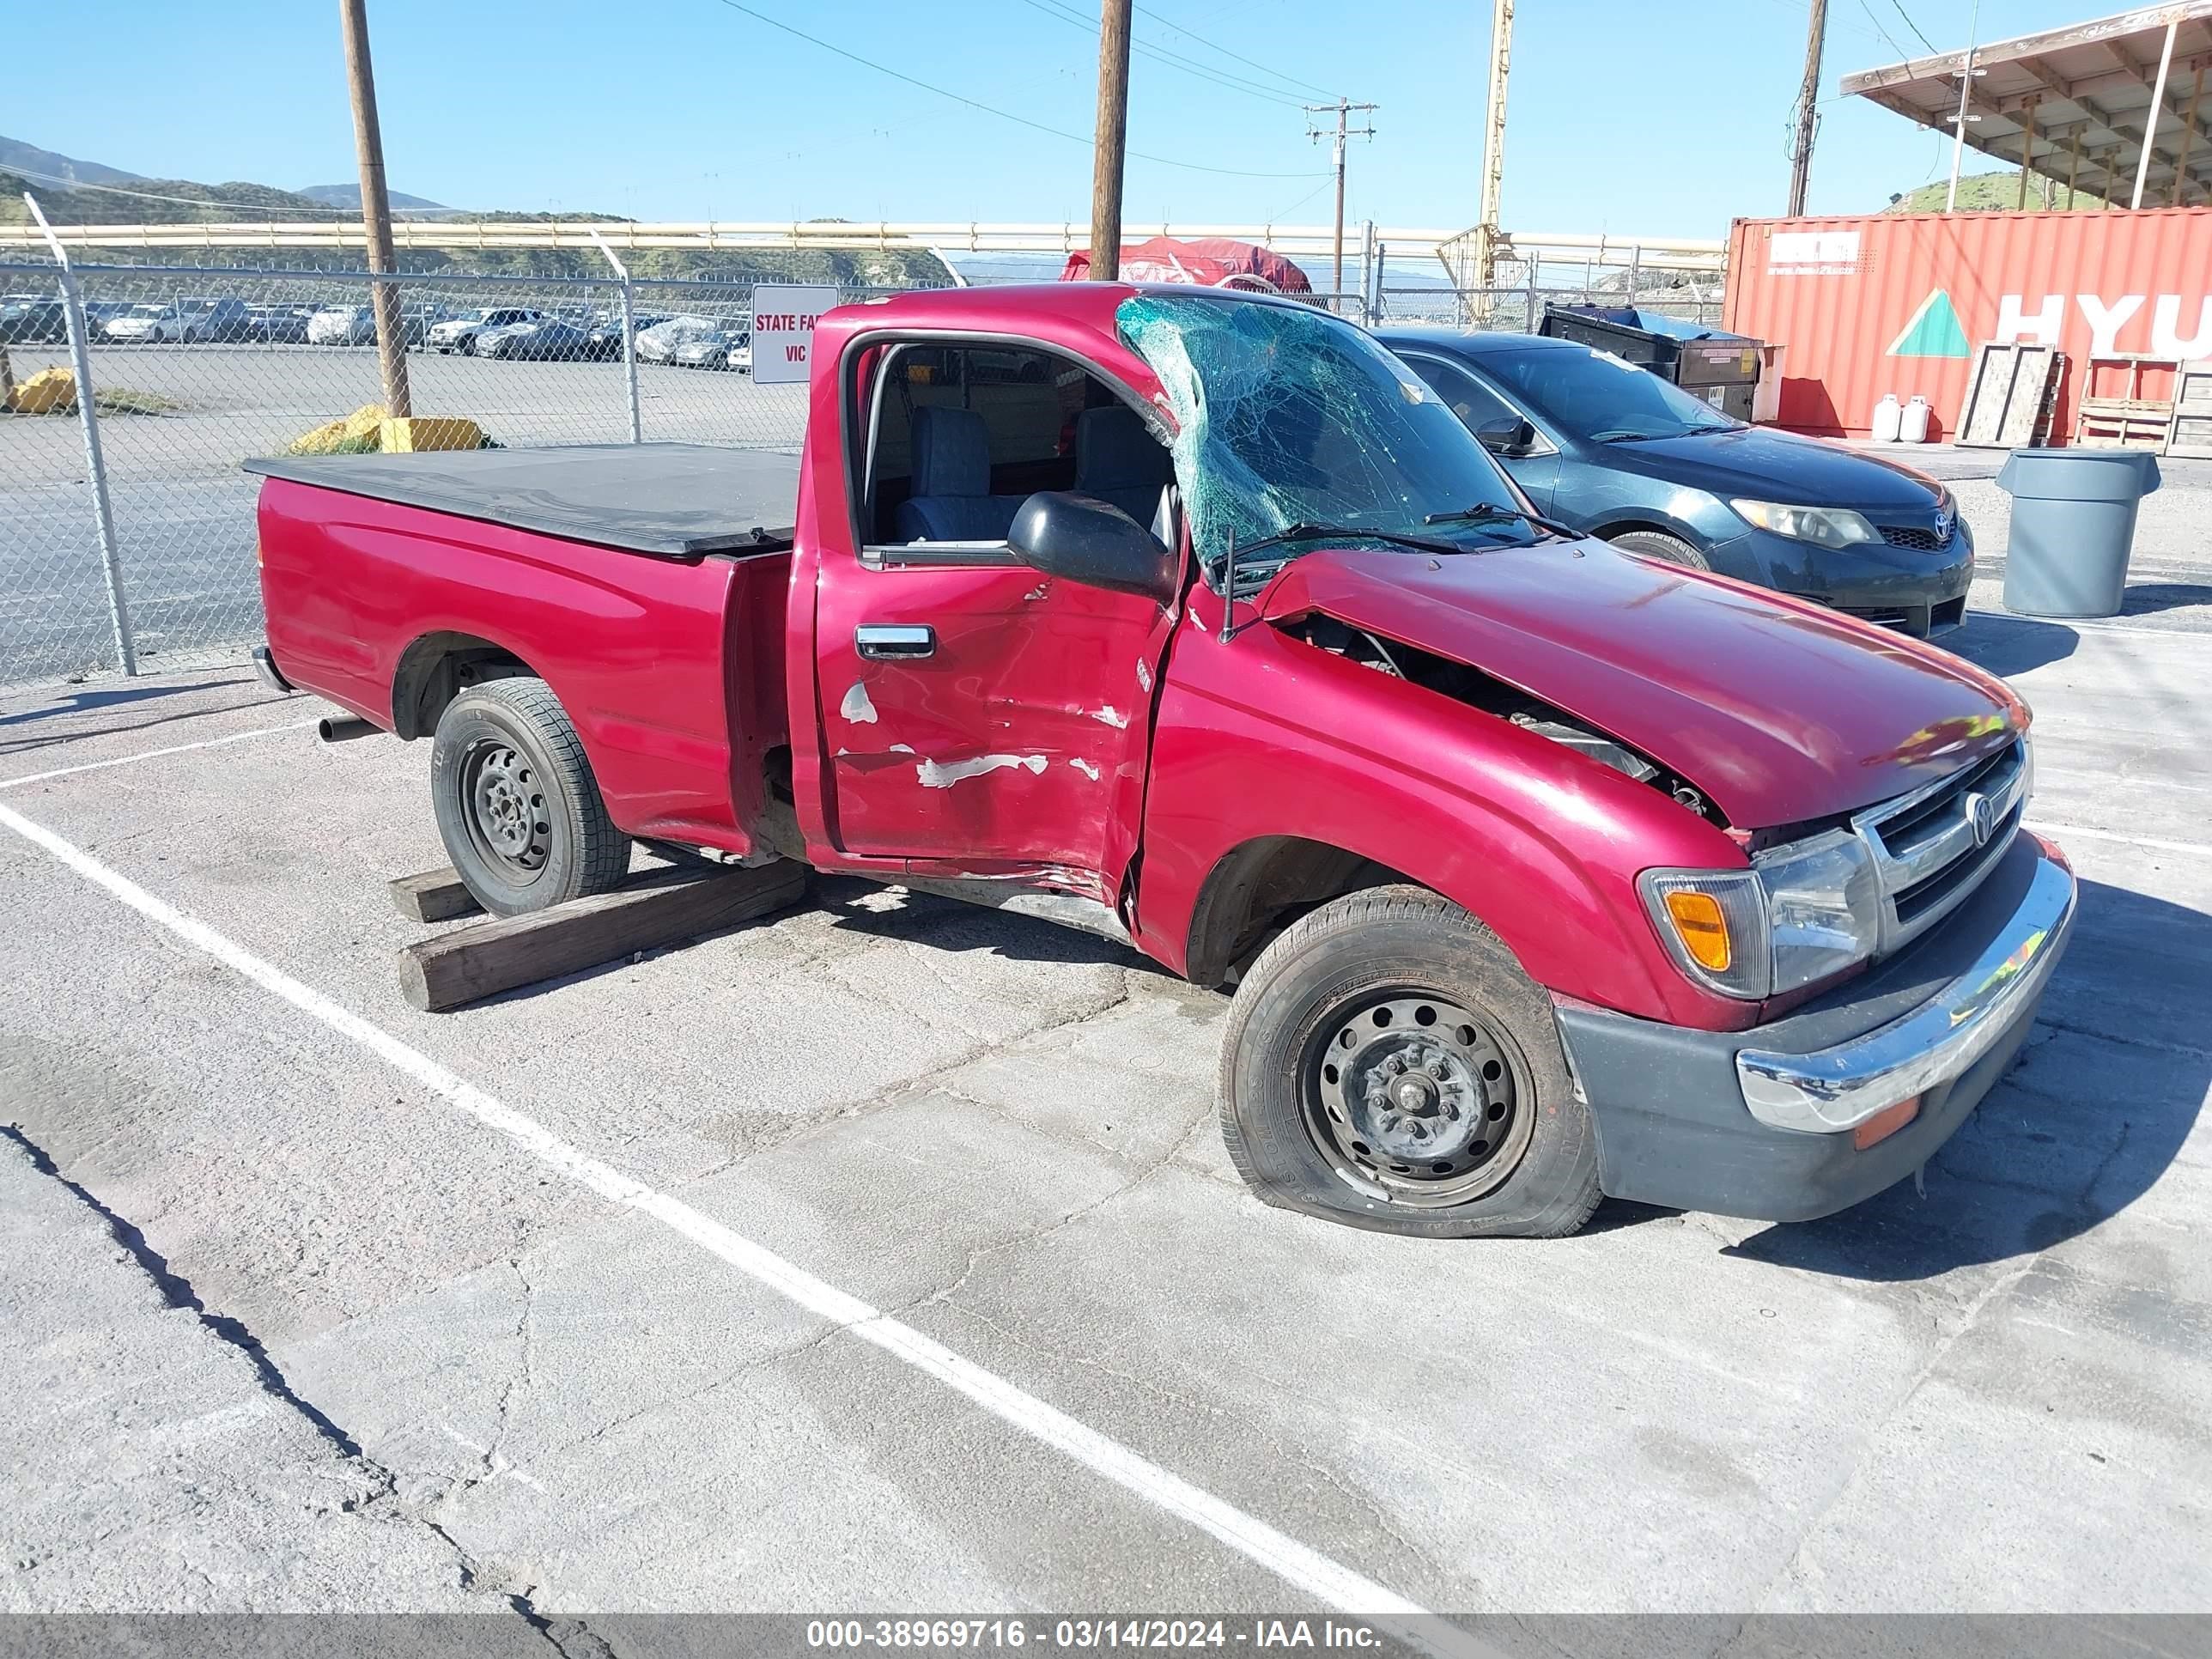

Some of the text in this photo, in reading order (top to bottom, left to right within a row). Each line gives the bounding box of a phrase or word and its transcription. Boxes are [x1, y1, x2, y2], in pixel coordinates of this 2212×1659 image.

[756, 314, 823, 331] STATE FA
[1996, 295, 2212, 360] HYU
[786, 345, 806, 362] VIC
